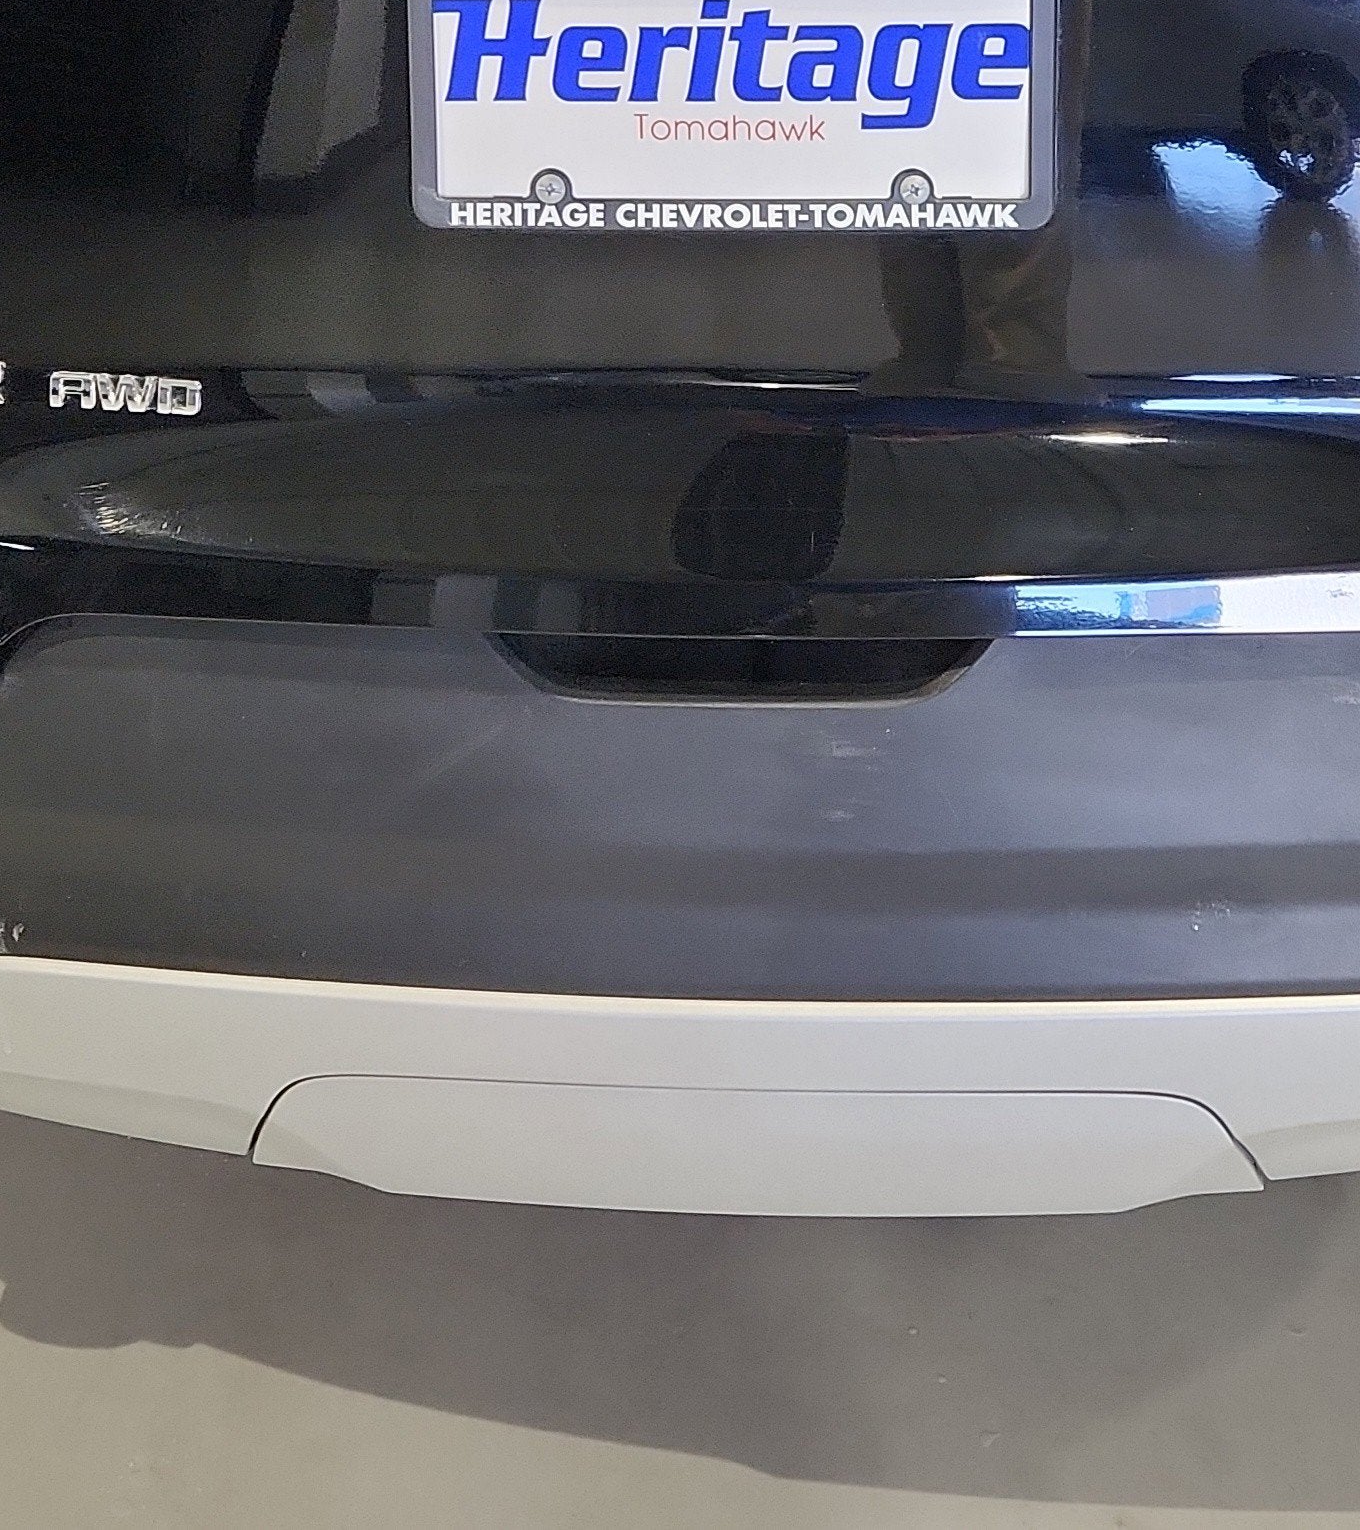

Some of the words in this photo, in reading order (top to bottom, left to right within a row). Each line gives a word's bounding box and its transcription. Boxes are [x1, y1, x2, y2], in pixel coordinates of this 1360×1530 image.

[633, 113, 826, 142] Tomahawk
[450, 202, 605, 228] HERITAGE
[615, 202, 1019, 229] CHEVROLET-TOMAHAWK
[48, 369, 203, 417] AWD
